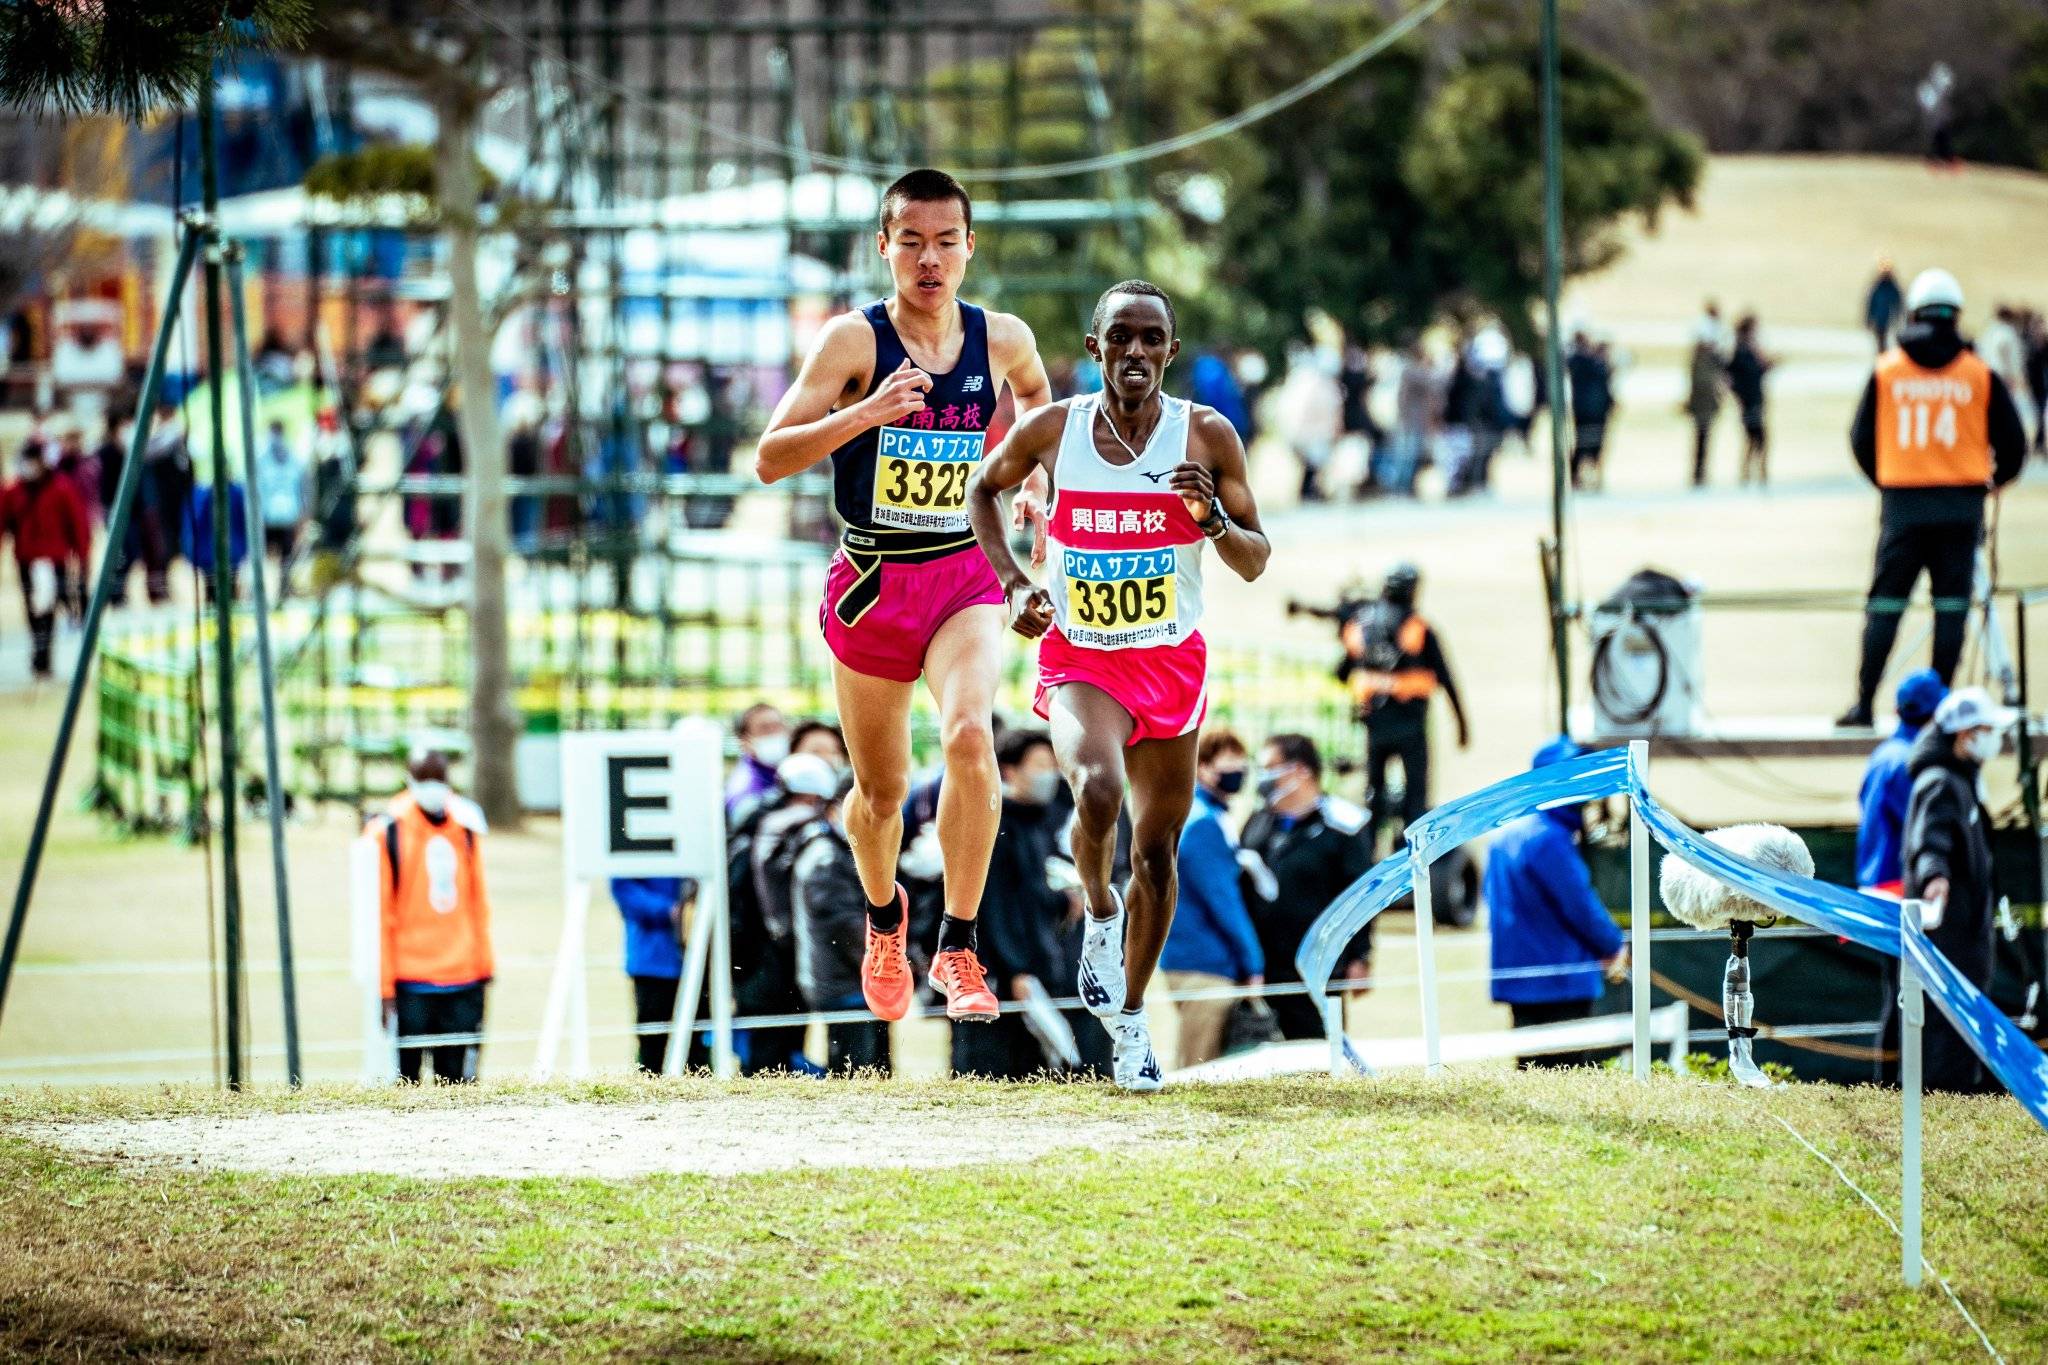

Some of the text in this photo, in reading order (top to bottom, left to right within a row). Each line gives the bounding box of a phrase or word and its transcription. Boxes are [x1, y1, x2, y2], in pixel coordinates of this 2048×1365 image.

[893, 403, 982, 430] 南高校
[1898, 403, 1957, 449] 114
[886, 460, 970, 507] 3323
[1071, 508, 1167, 534] 興國高校
[1075, 577, 1167, 627] 3305
[608, 755, 675, 853] E
